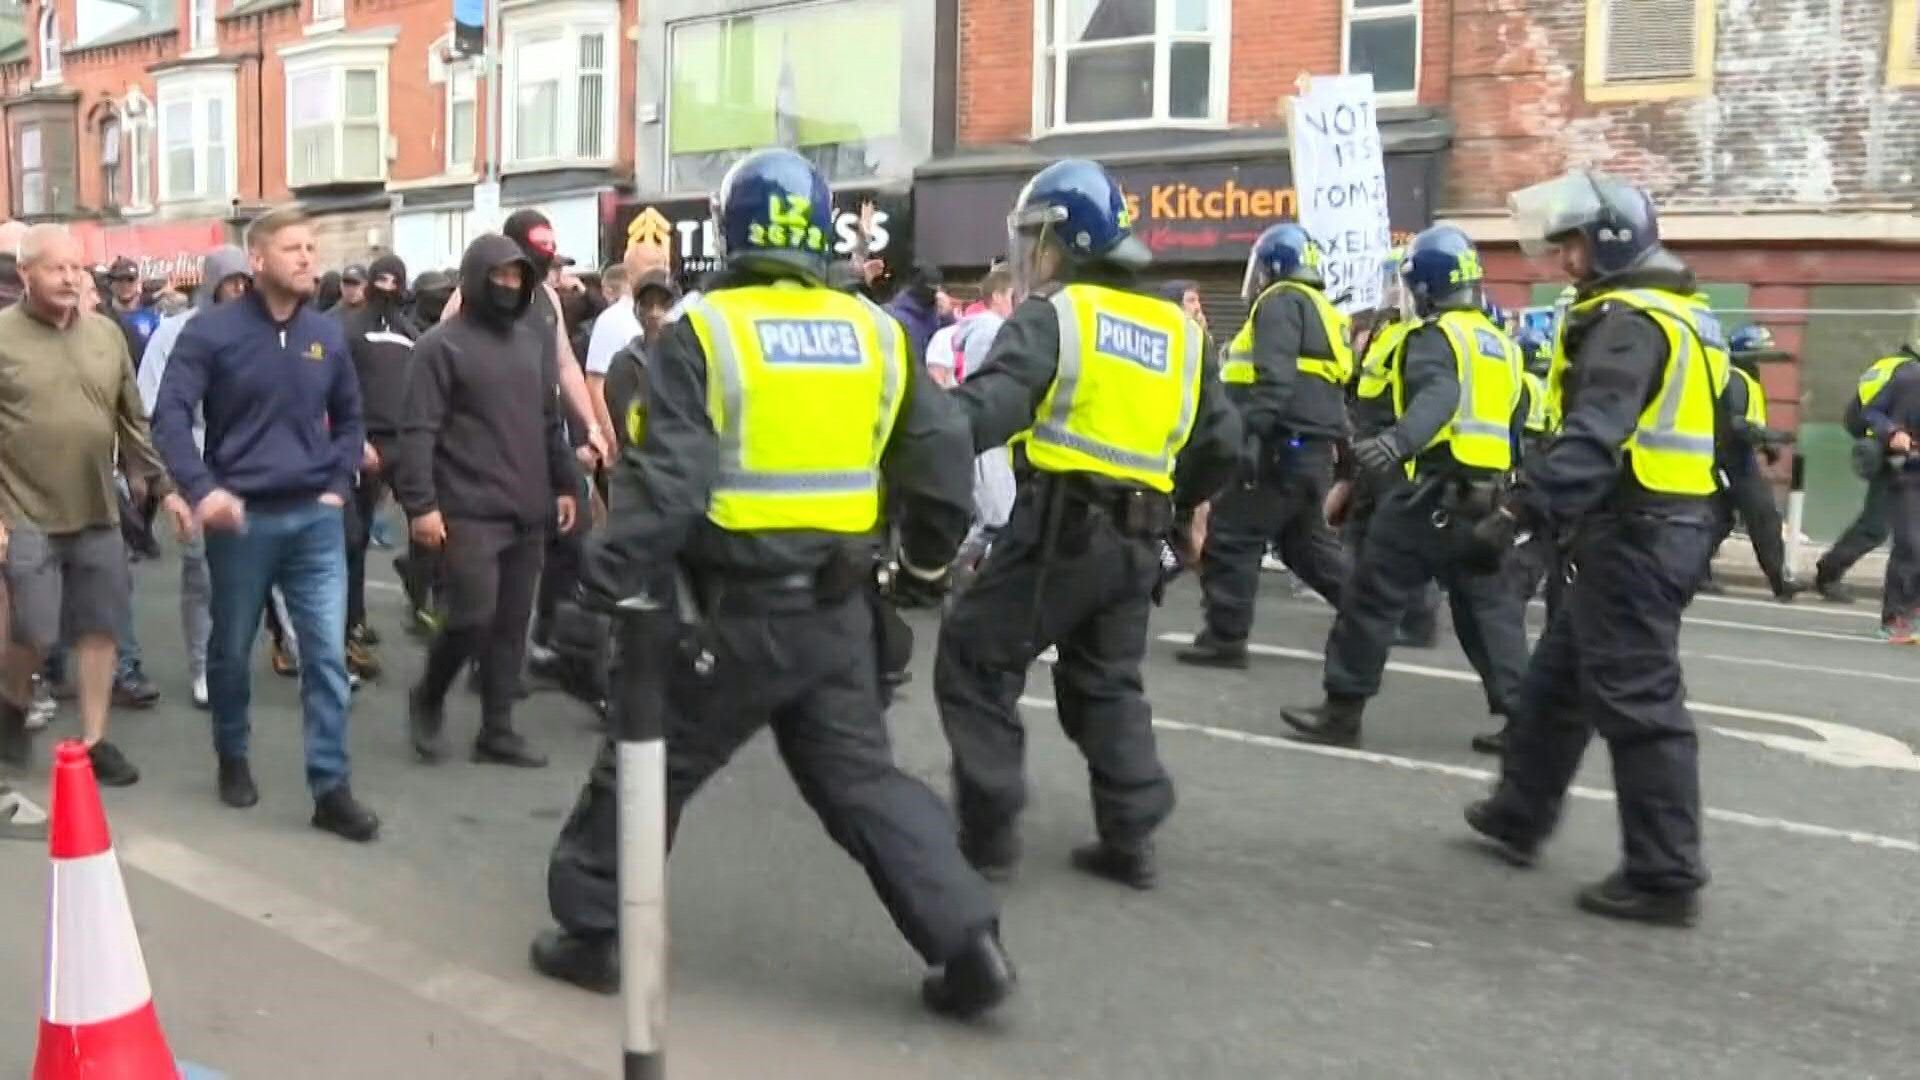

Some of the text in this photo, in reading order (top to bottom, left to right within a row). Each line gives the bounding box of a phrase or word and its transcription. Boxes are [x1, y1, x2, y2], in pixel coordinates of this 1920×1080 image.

[769, 195, 811, 226] LZ
[1151, 179, 1296, 220] Kitchen
[759, 322, 859, 356] POLICE
[1099, 318, 1165, 366] POLICE
